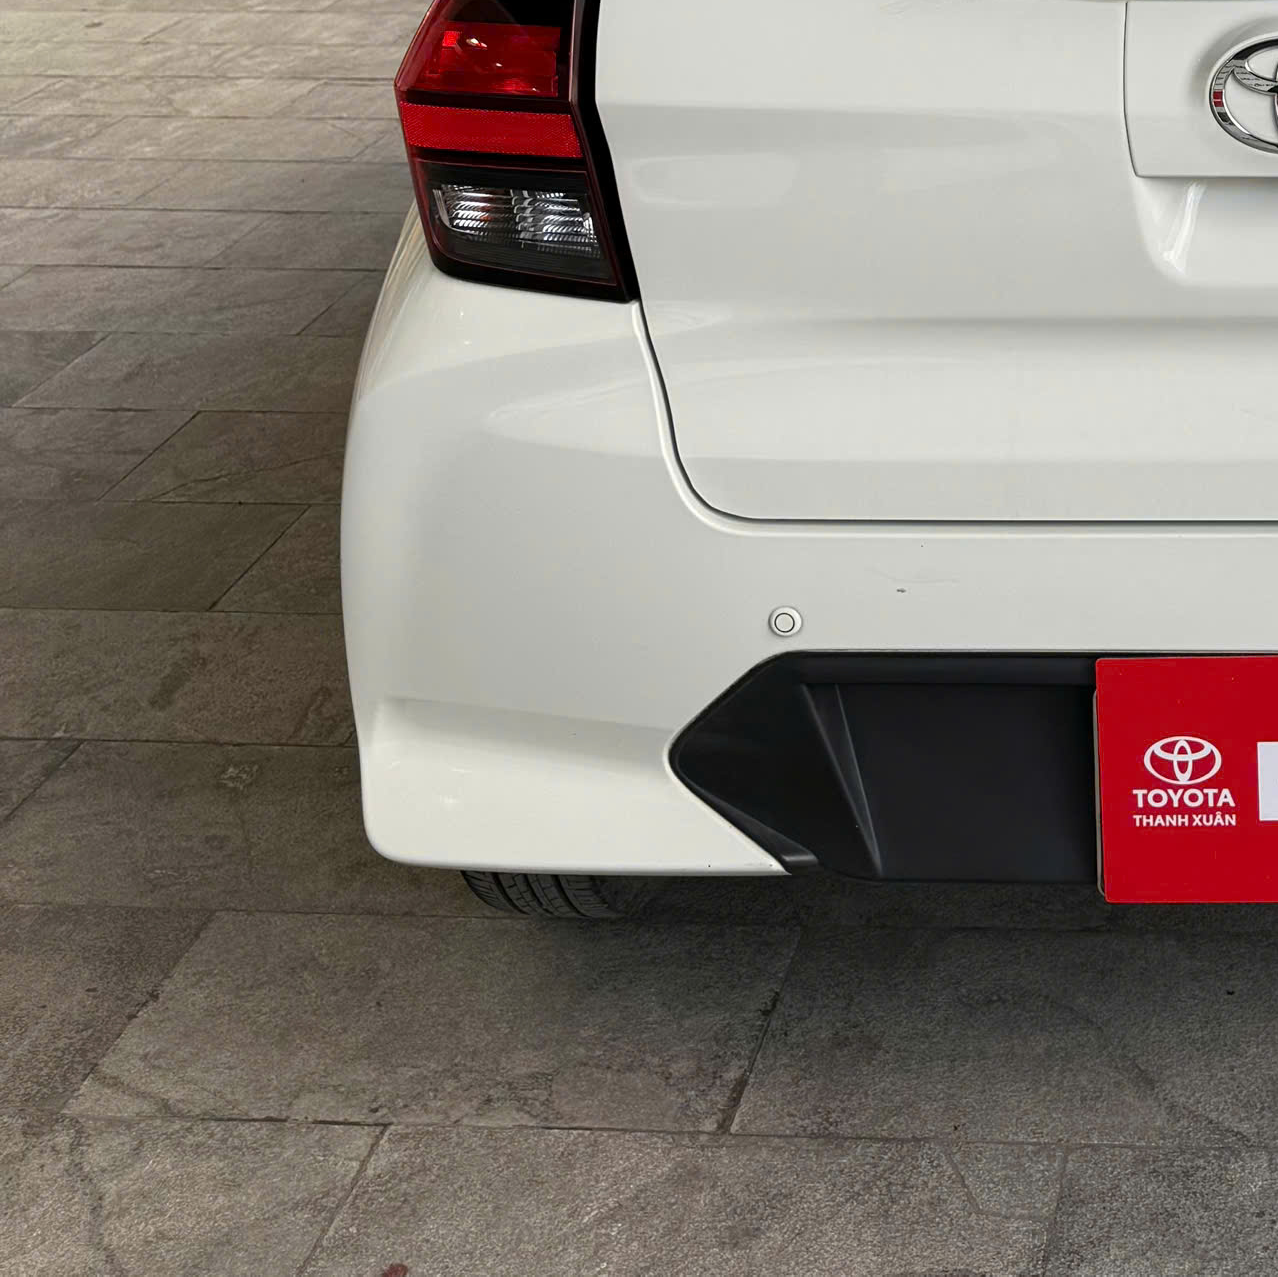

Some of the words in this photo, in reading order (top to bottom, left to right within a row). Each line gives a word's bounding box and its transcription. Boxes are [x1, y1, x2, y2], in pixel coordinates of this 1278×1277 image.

[1132, 788, 1236, 808] TOYOTA
[1132, 814, 1189, 827] THANH
[1192, 811, 1237, 826] XUÂN
